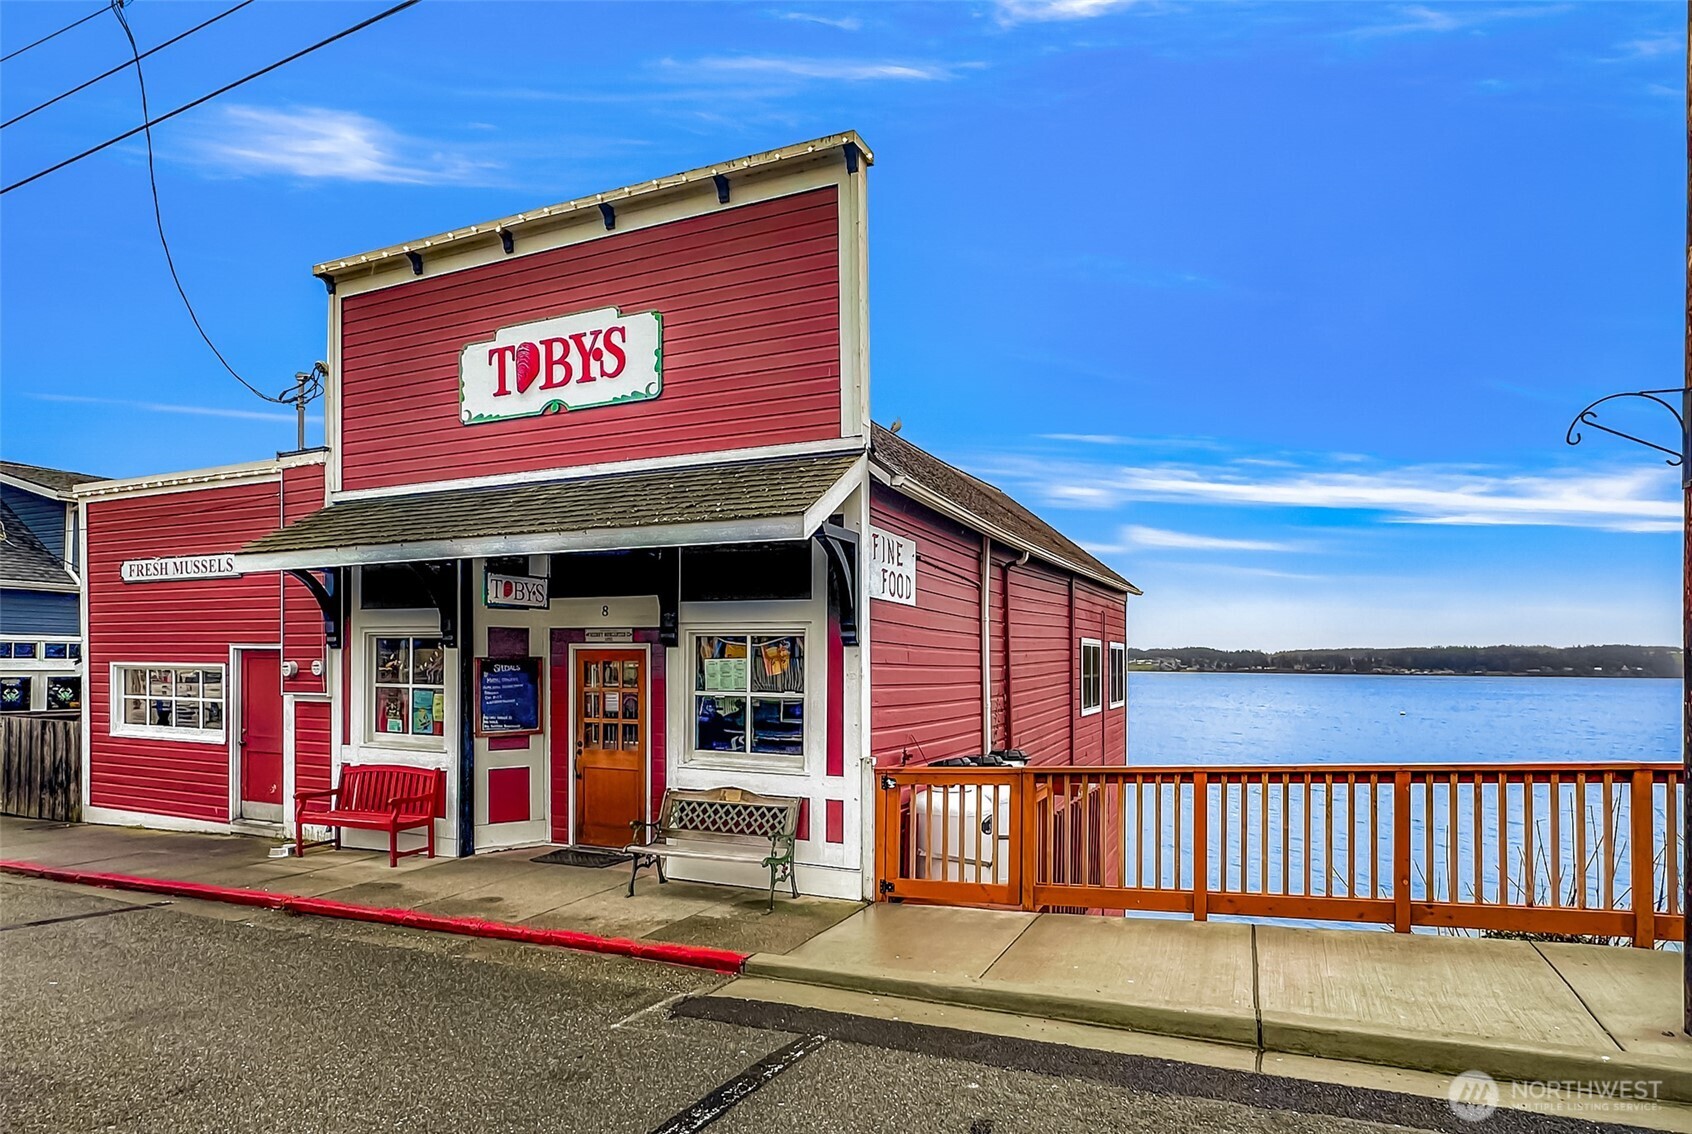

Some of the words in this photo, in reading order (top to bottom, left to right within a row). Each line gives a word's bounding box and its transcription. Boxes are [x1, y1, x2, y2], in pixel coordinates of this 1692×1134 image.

[872, 533, 903, 567] FINE
[128, 562, 169, 577] FRESH
[172, 557, 234, 576] MUSSELS
[881, 568, 912, 600] FOOD
[601, 605, 609, 617] 8
